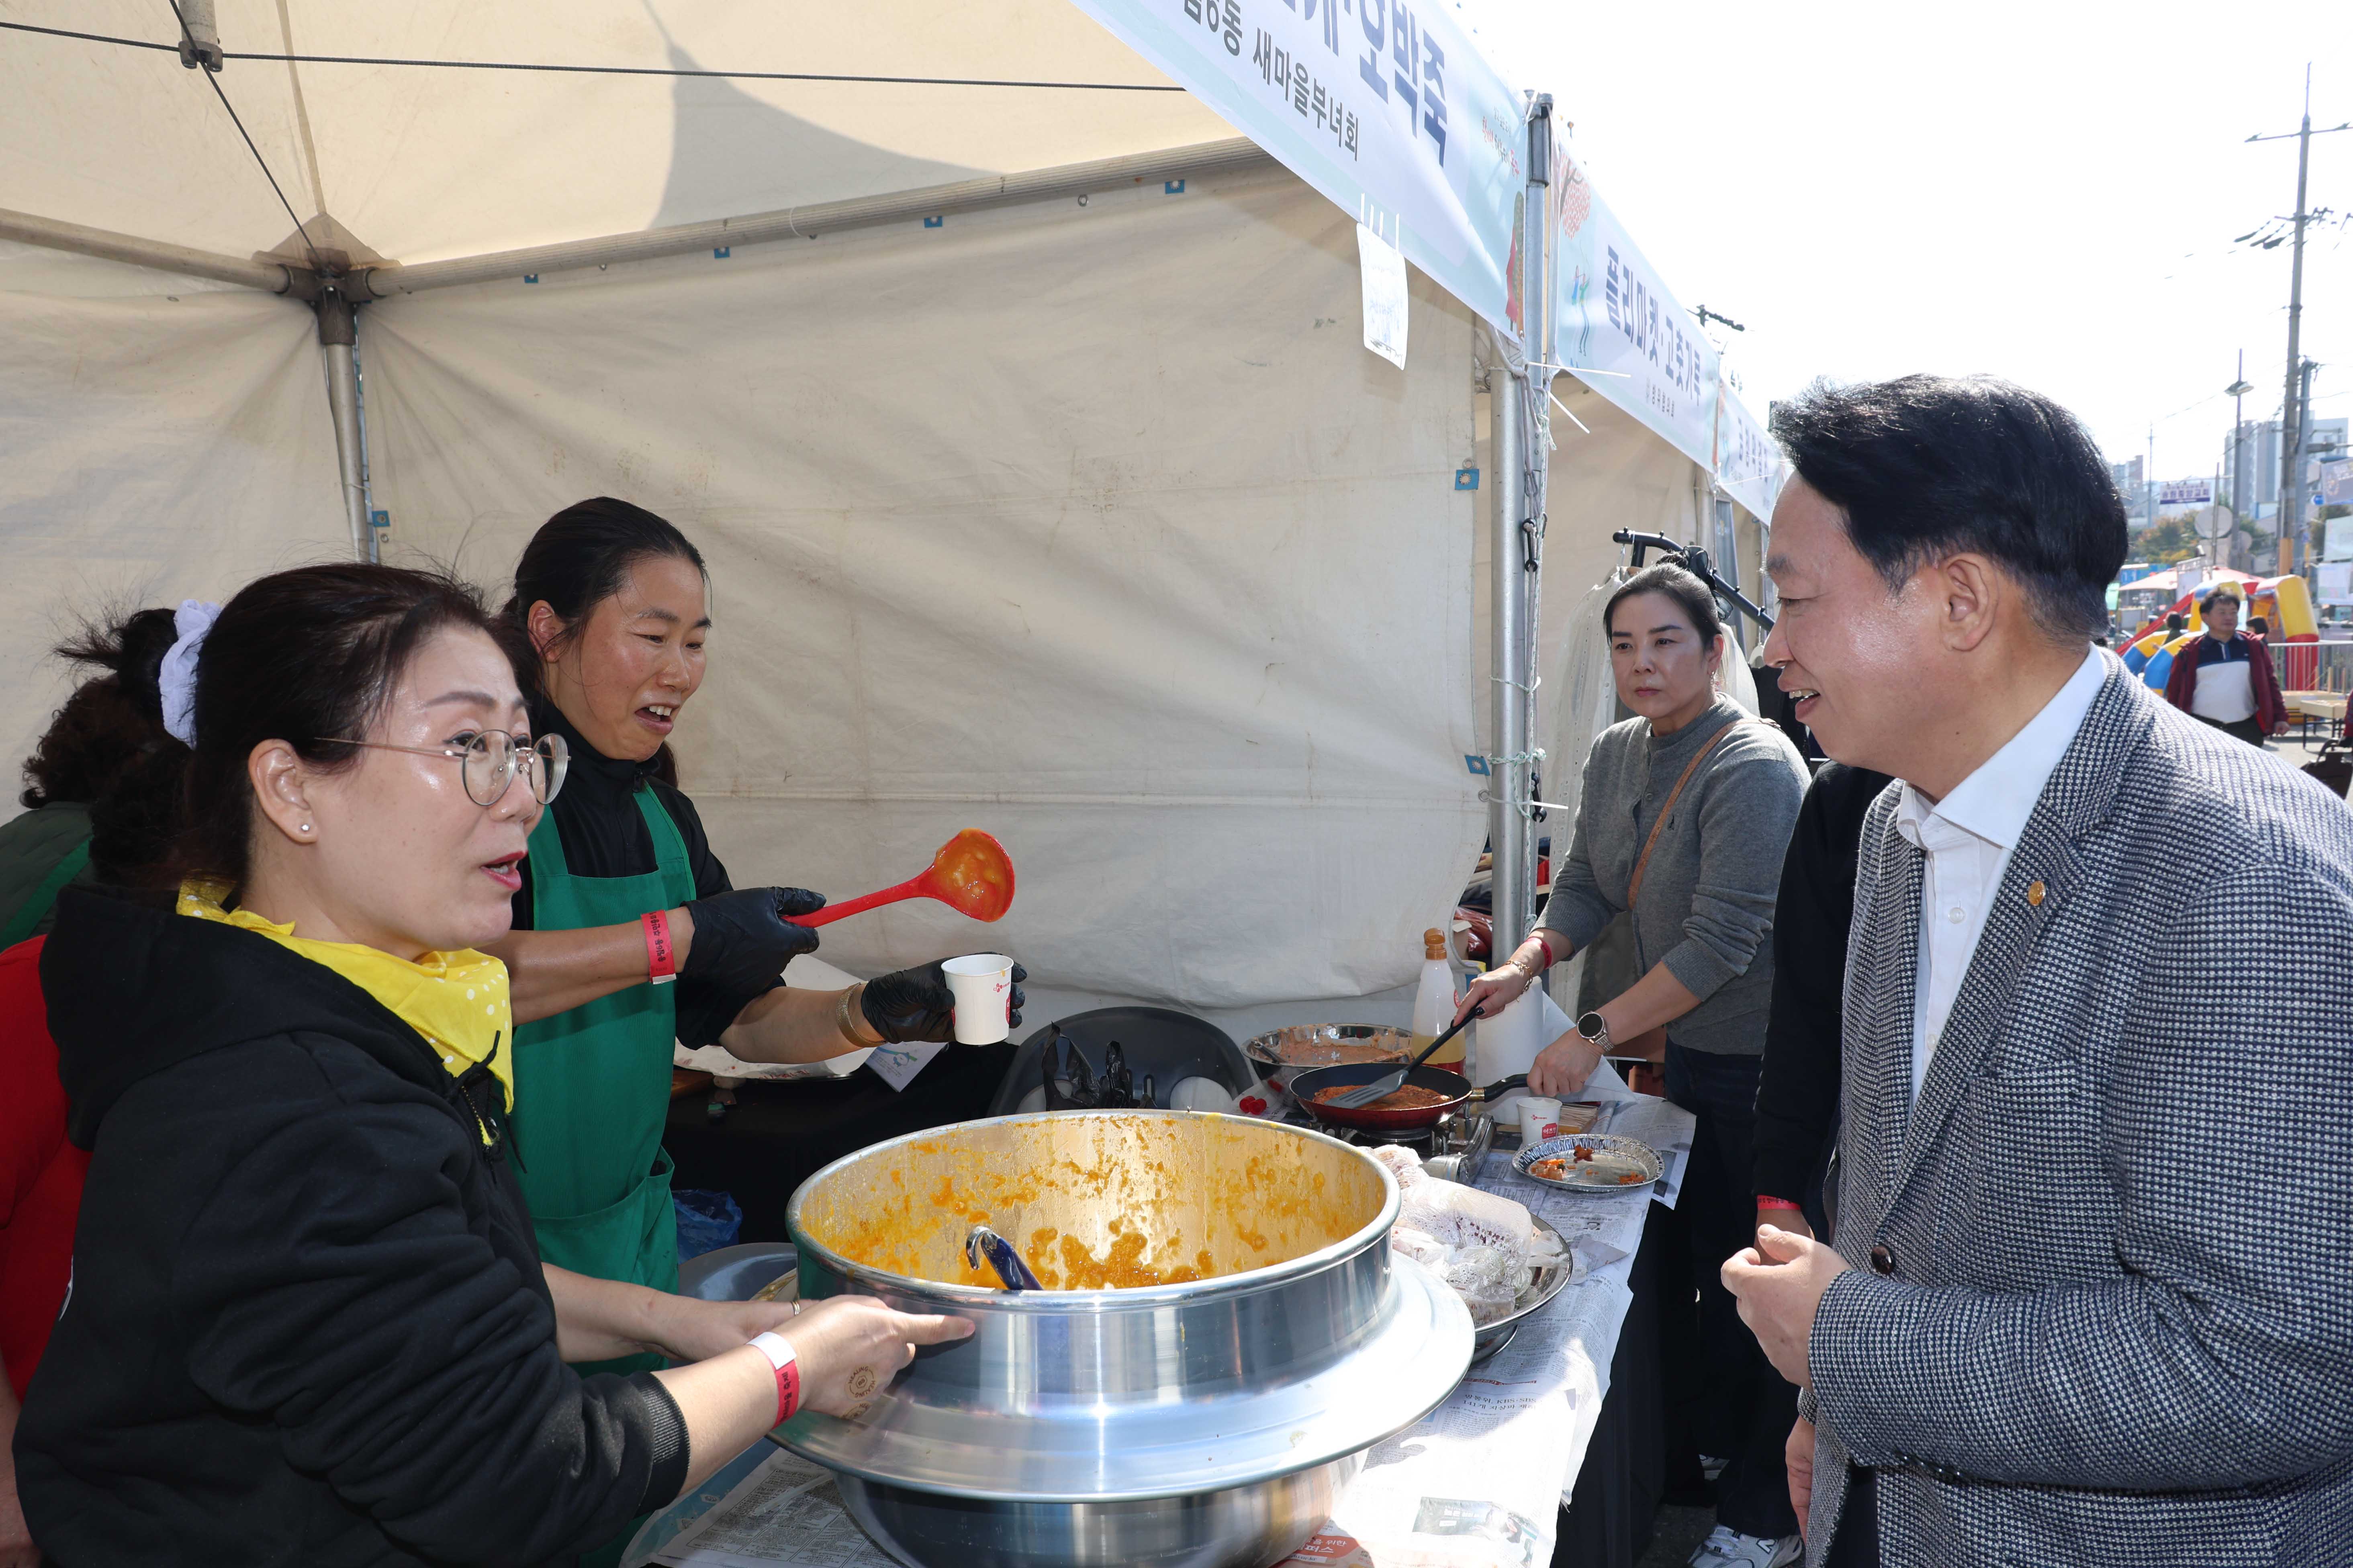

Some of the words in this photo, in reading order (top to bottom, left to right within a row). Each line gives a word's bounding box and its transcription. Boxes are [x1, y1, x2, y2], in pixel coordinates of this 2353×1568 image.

[1253, 27, 1358, 161] 새마을부녀회
[848, 1366, 869, 1384] HEALING
[855, 1380, 875, 1398] HEALING
